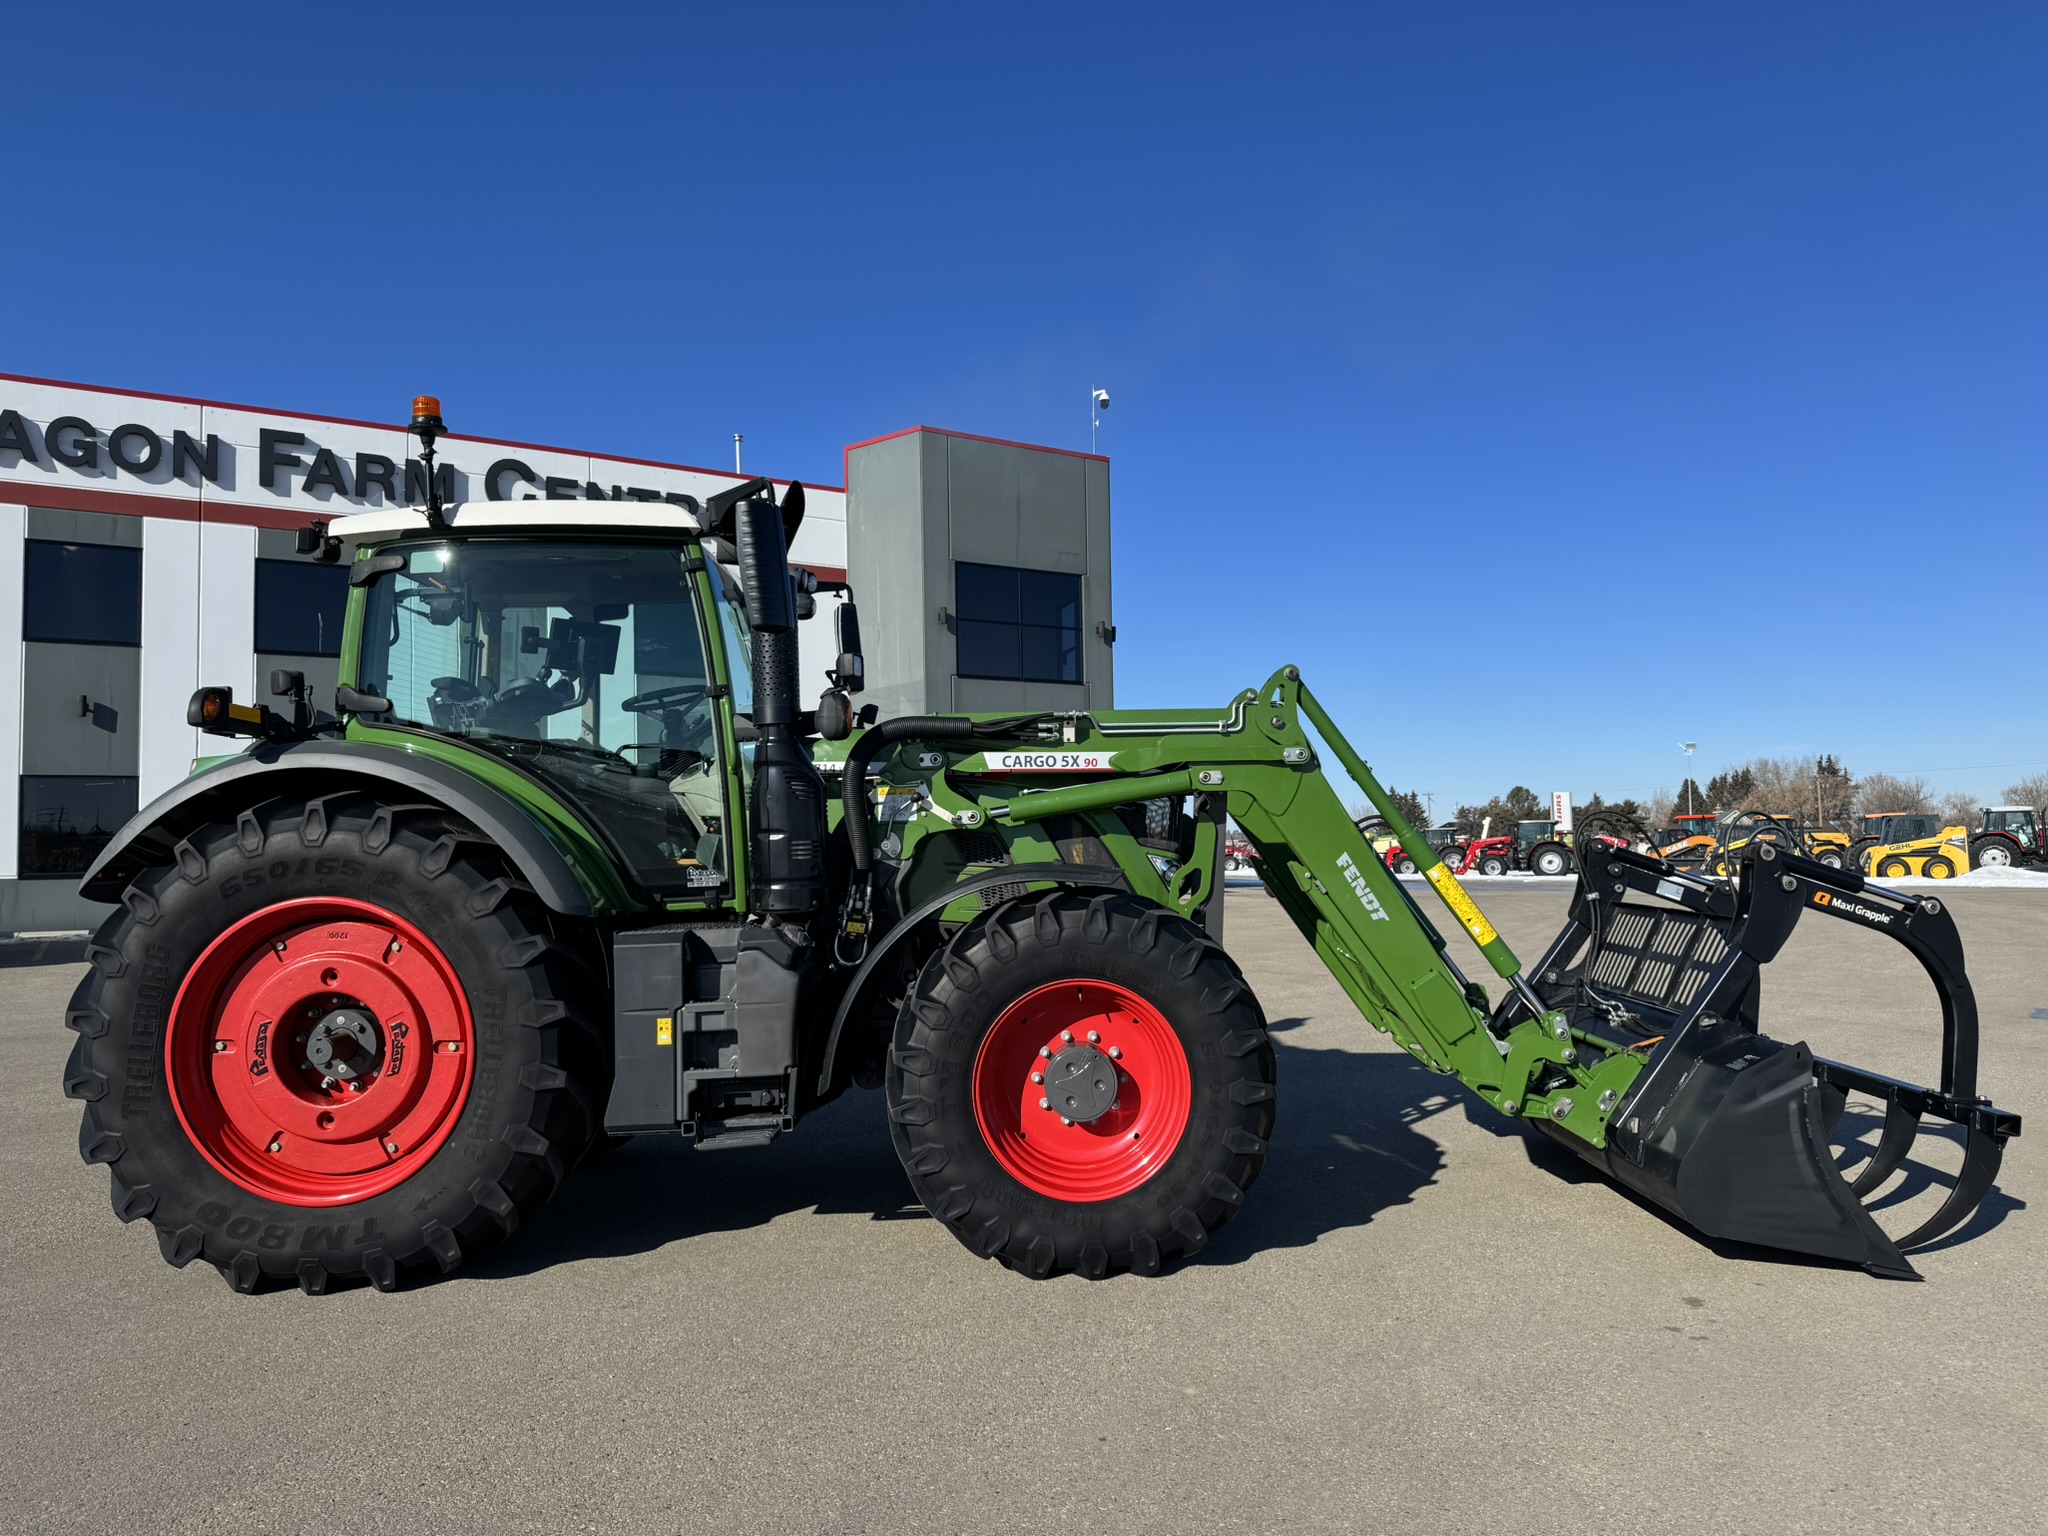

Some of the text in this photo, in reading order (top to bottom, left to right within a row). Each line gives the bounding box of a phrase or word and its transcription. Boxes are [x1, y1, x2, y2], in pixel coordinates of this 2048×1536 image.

[0, 409, 219, 482] AGON
[259, 428, 455, 503] FARM
[1002, 755, 1098, 768] CARGO 5X 90
[1888, 842, 1914, 852] GEHL
[218, 858, 366, 899] 650/65
[1336, 851, 1390, 921] FENDT
[1831, 897, 1854, 912] Maxi
[121, 943, 171, 1121] TRELLEBORG
